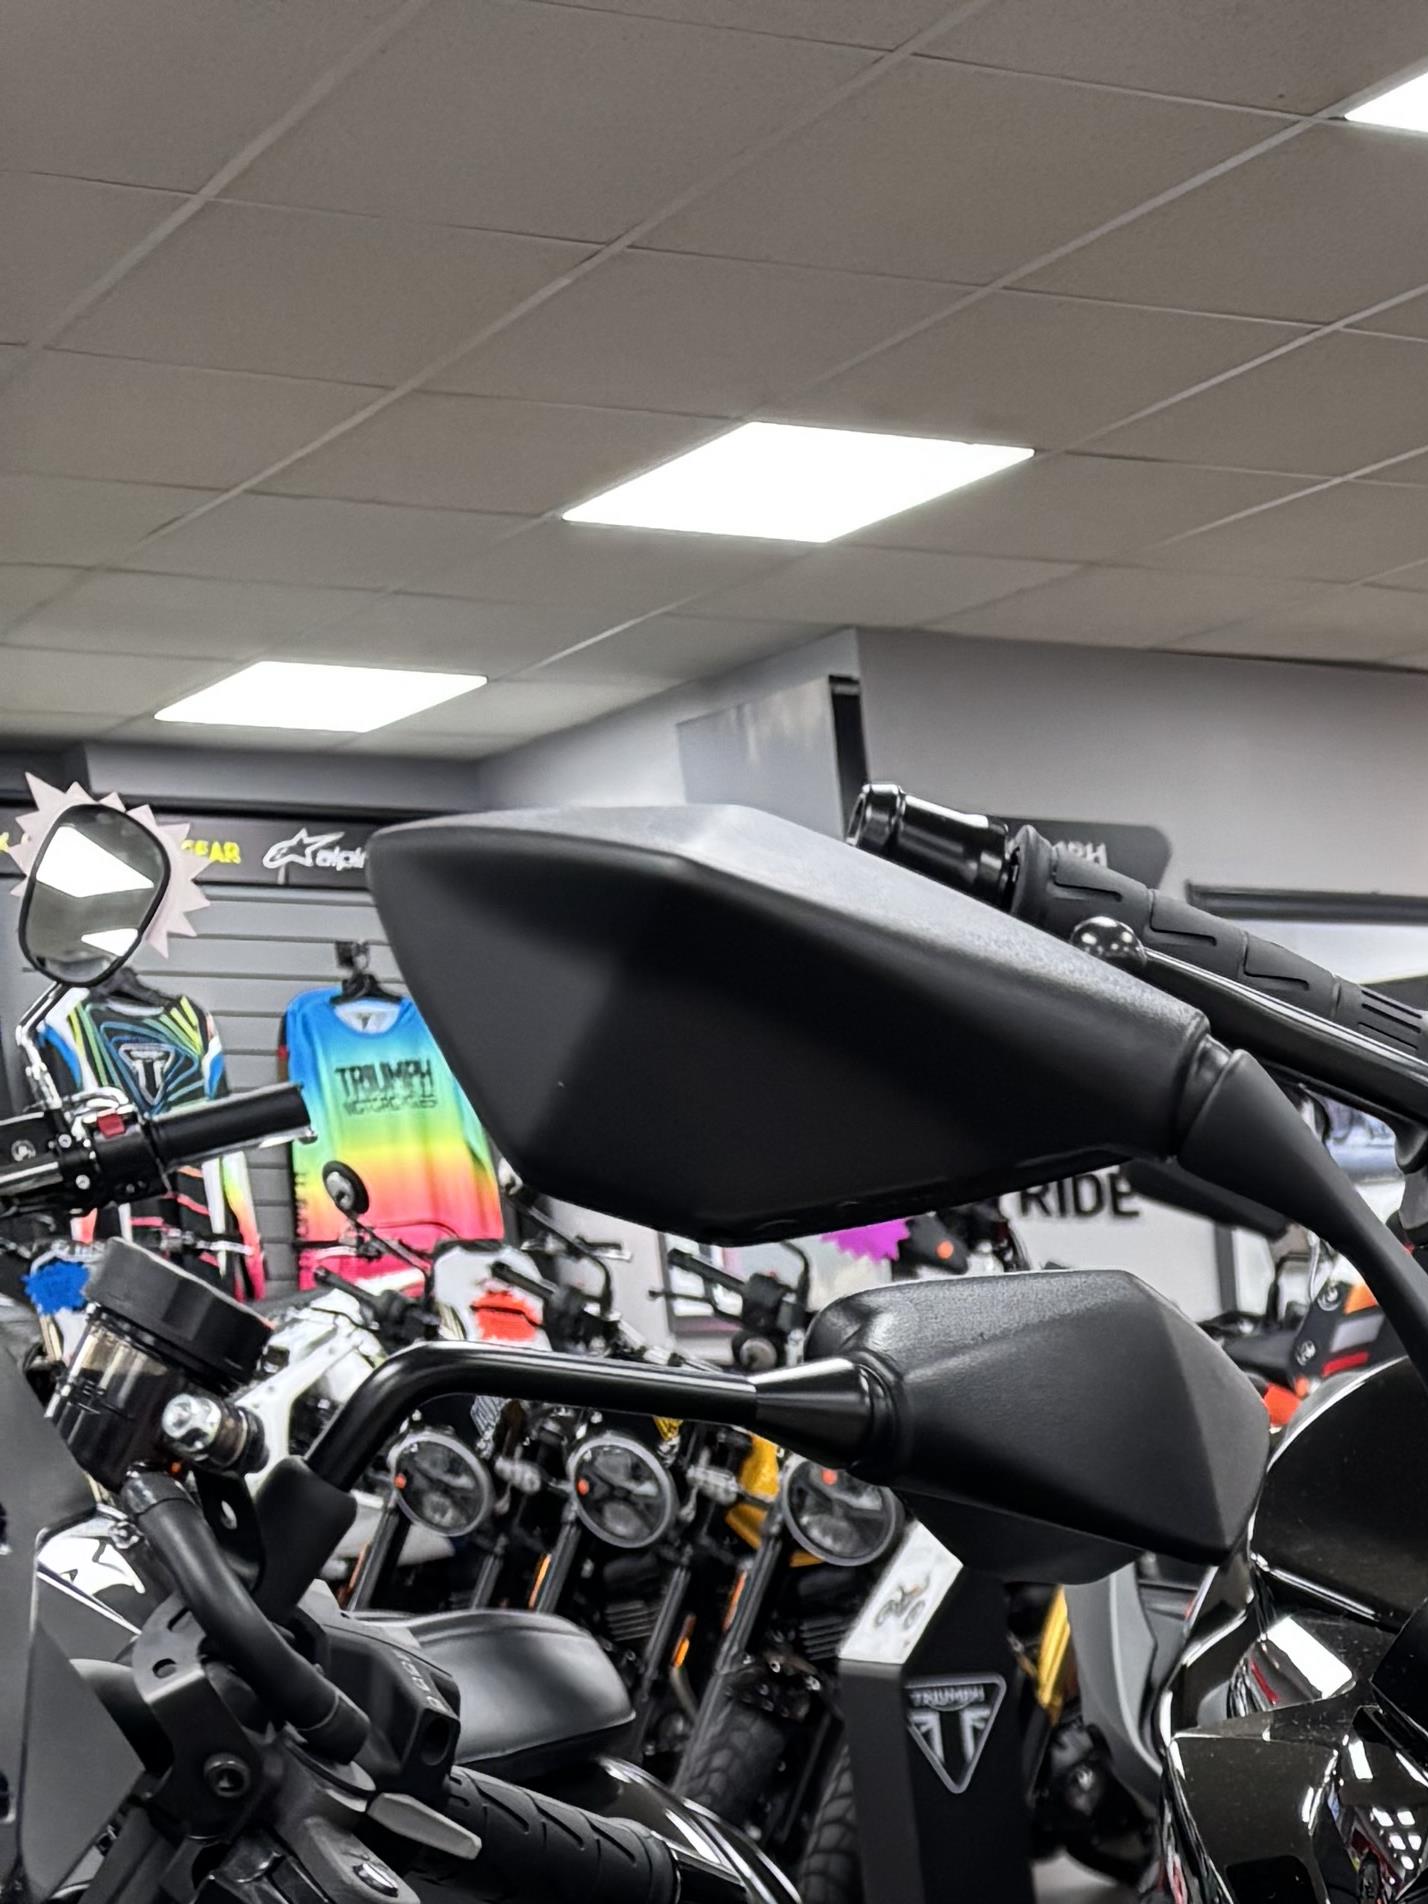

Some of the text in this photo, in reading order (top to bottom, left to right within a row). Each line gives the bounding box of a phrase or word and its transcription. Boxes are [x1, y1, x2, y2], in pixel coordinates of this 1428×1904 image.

[334, 1058, 435, 1098] TRIUMPH
[1019, 1172, 1141, 1218] RIDE
[910, 1684, 985, 1708] TRIUMPH
